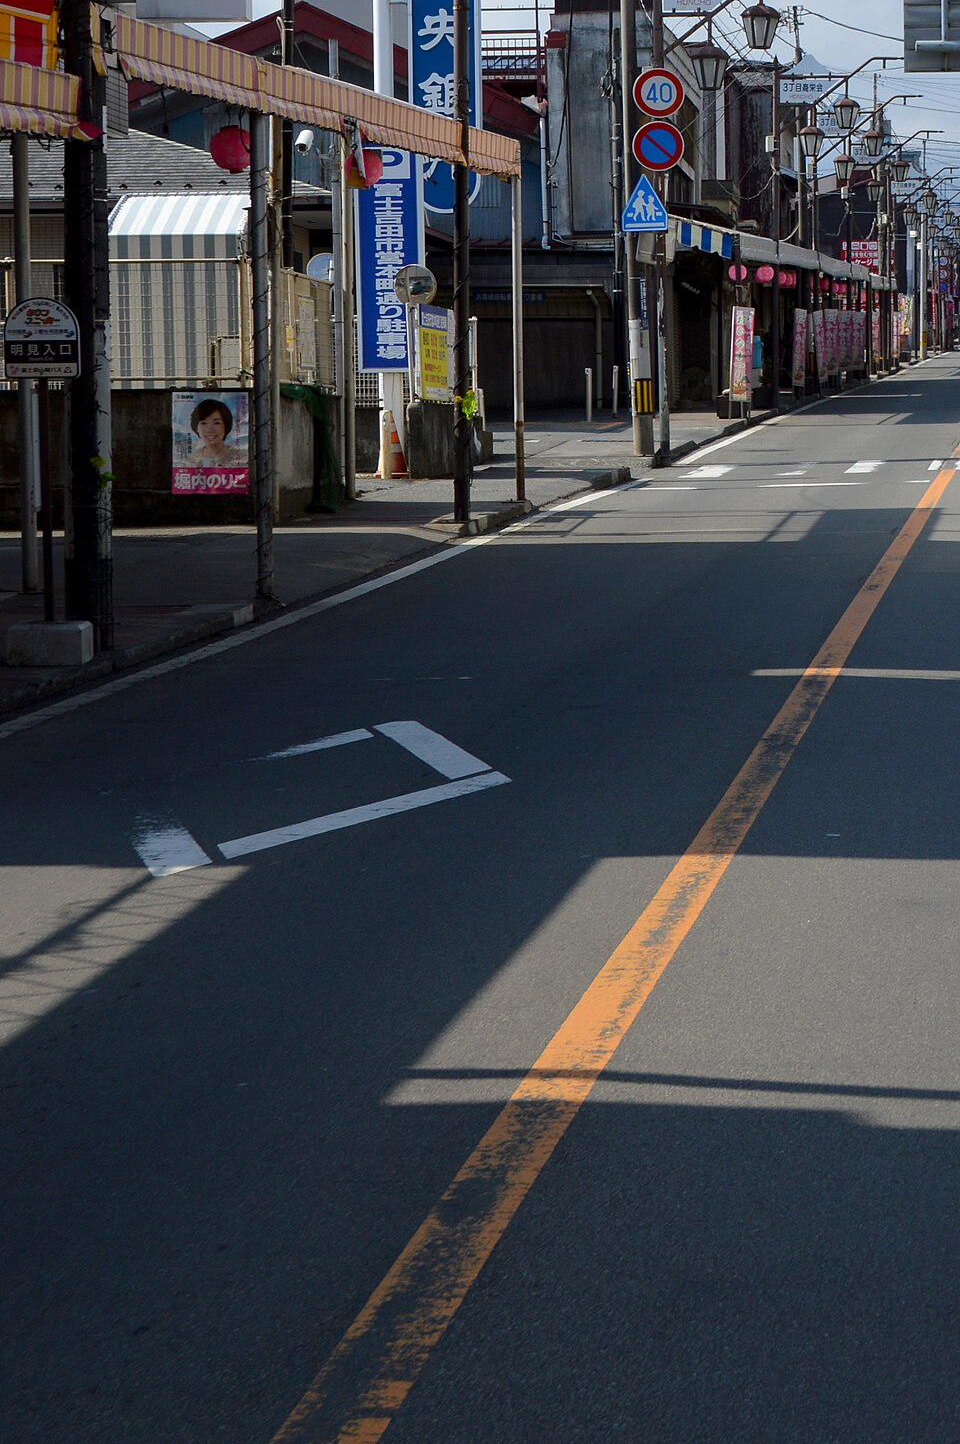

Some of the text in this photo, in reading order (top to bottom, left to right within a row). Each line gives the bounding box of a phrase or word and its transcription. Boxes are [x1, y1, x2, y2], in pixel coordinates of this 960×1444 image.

[645, 83, 673, 103] 40
[782, 82, 823, 93] 3丁目商栄会
[10, 344, 72, 356] 明見入口
[174, 473, 247, 490] 堀内のりこ
